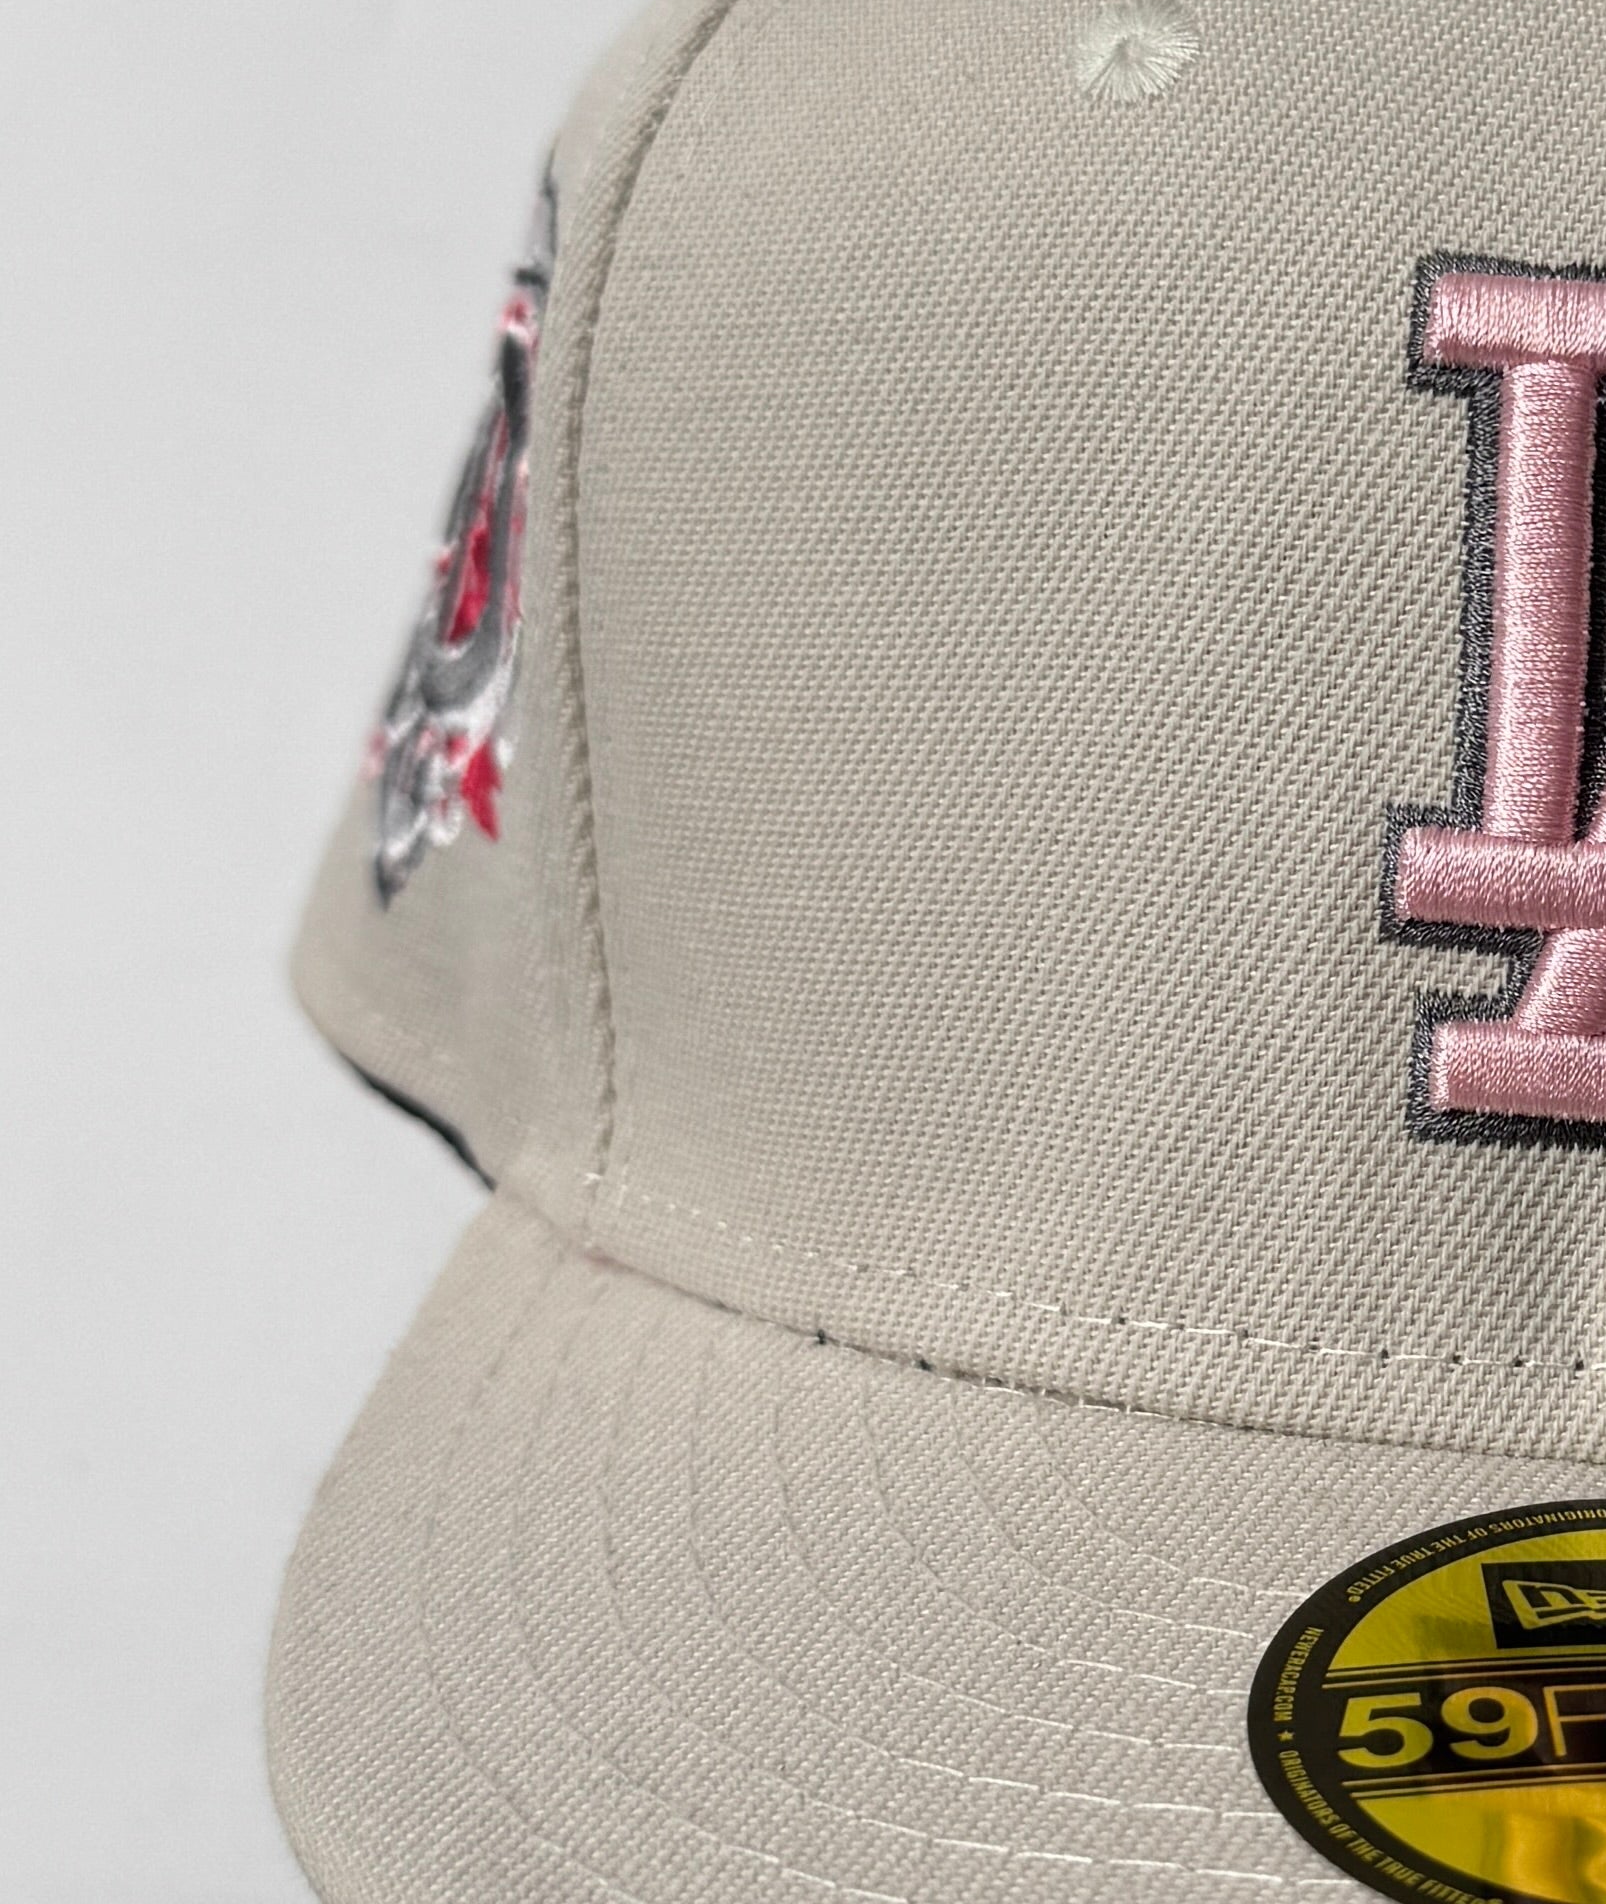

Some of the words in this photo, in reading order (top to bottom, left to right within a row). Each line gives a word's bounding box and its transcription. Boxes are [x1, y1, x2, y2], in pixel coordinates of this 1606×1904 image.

[1435, 1533, 1467, 1554] THE
[1466, 1526, 1489, 1541] OF
[1397, 1545, 1435, 1570] TRUE
[1278, 1749, 1334, 1825] ORIGINATORS
[1329, 1822, 1357, 1844] OF
[1346, 1835, 1383, 1861] THE
[1374, 1856, 1426, 1887] TRUE
